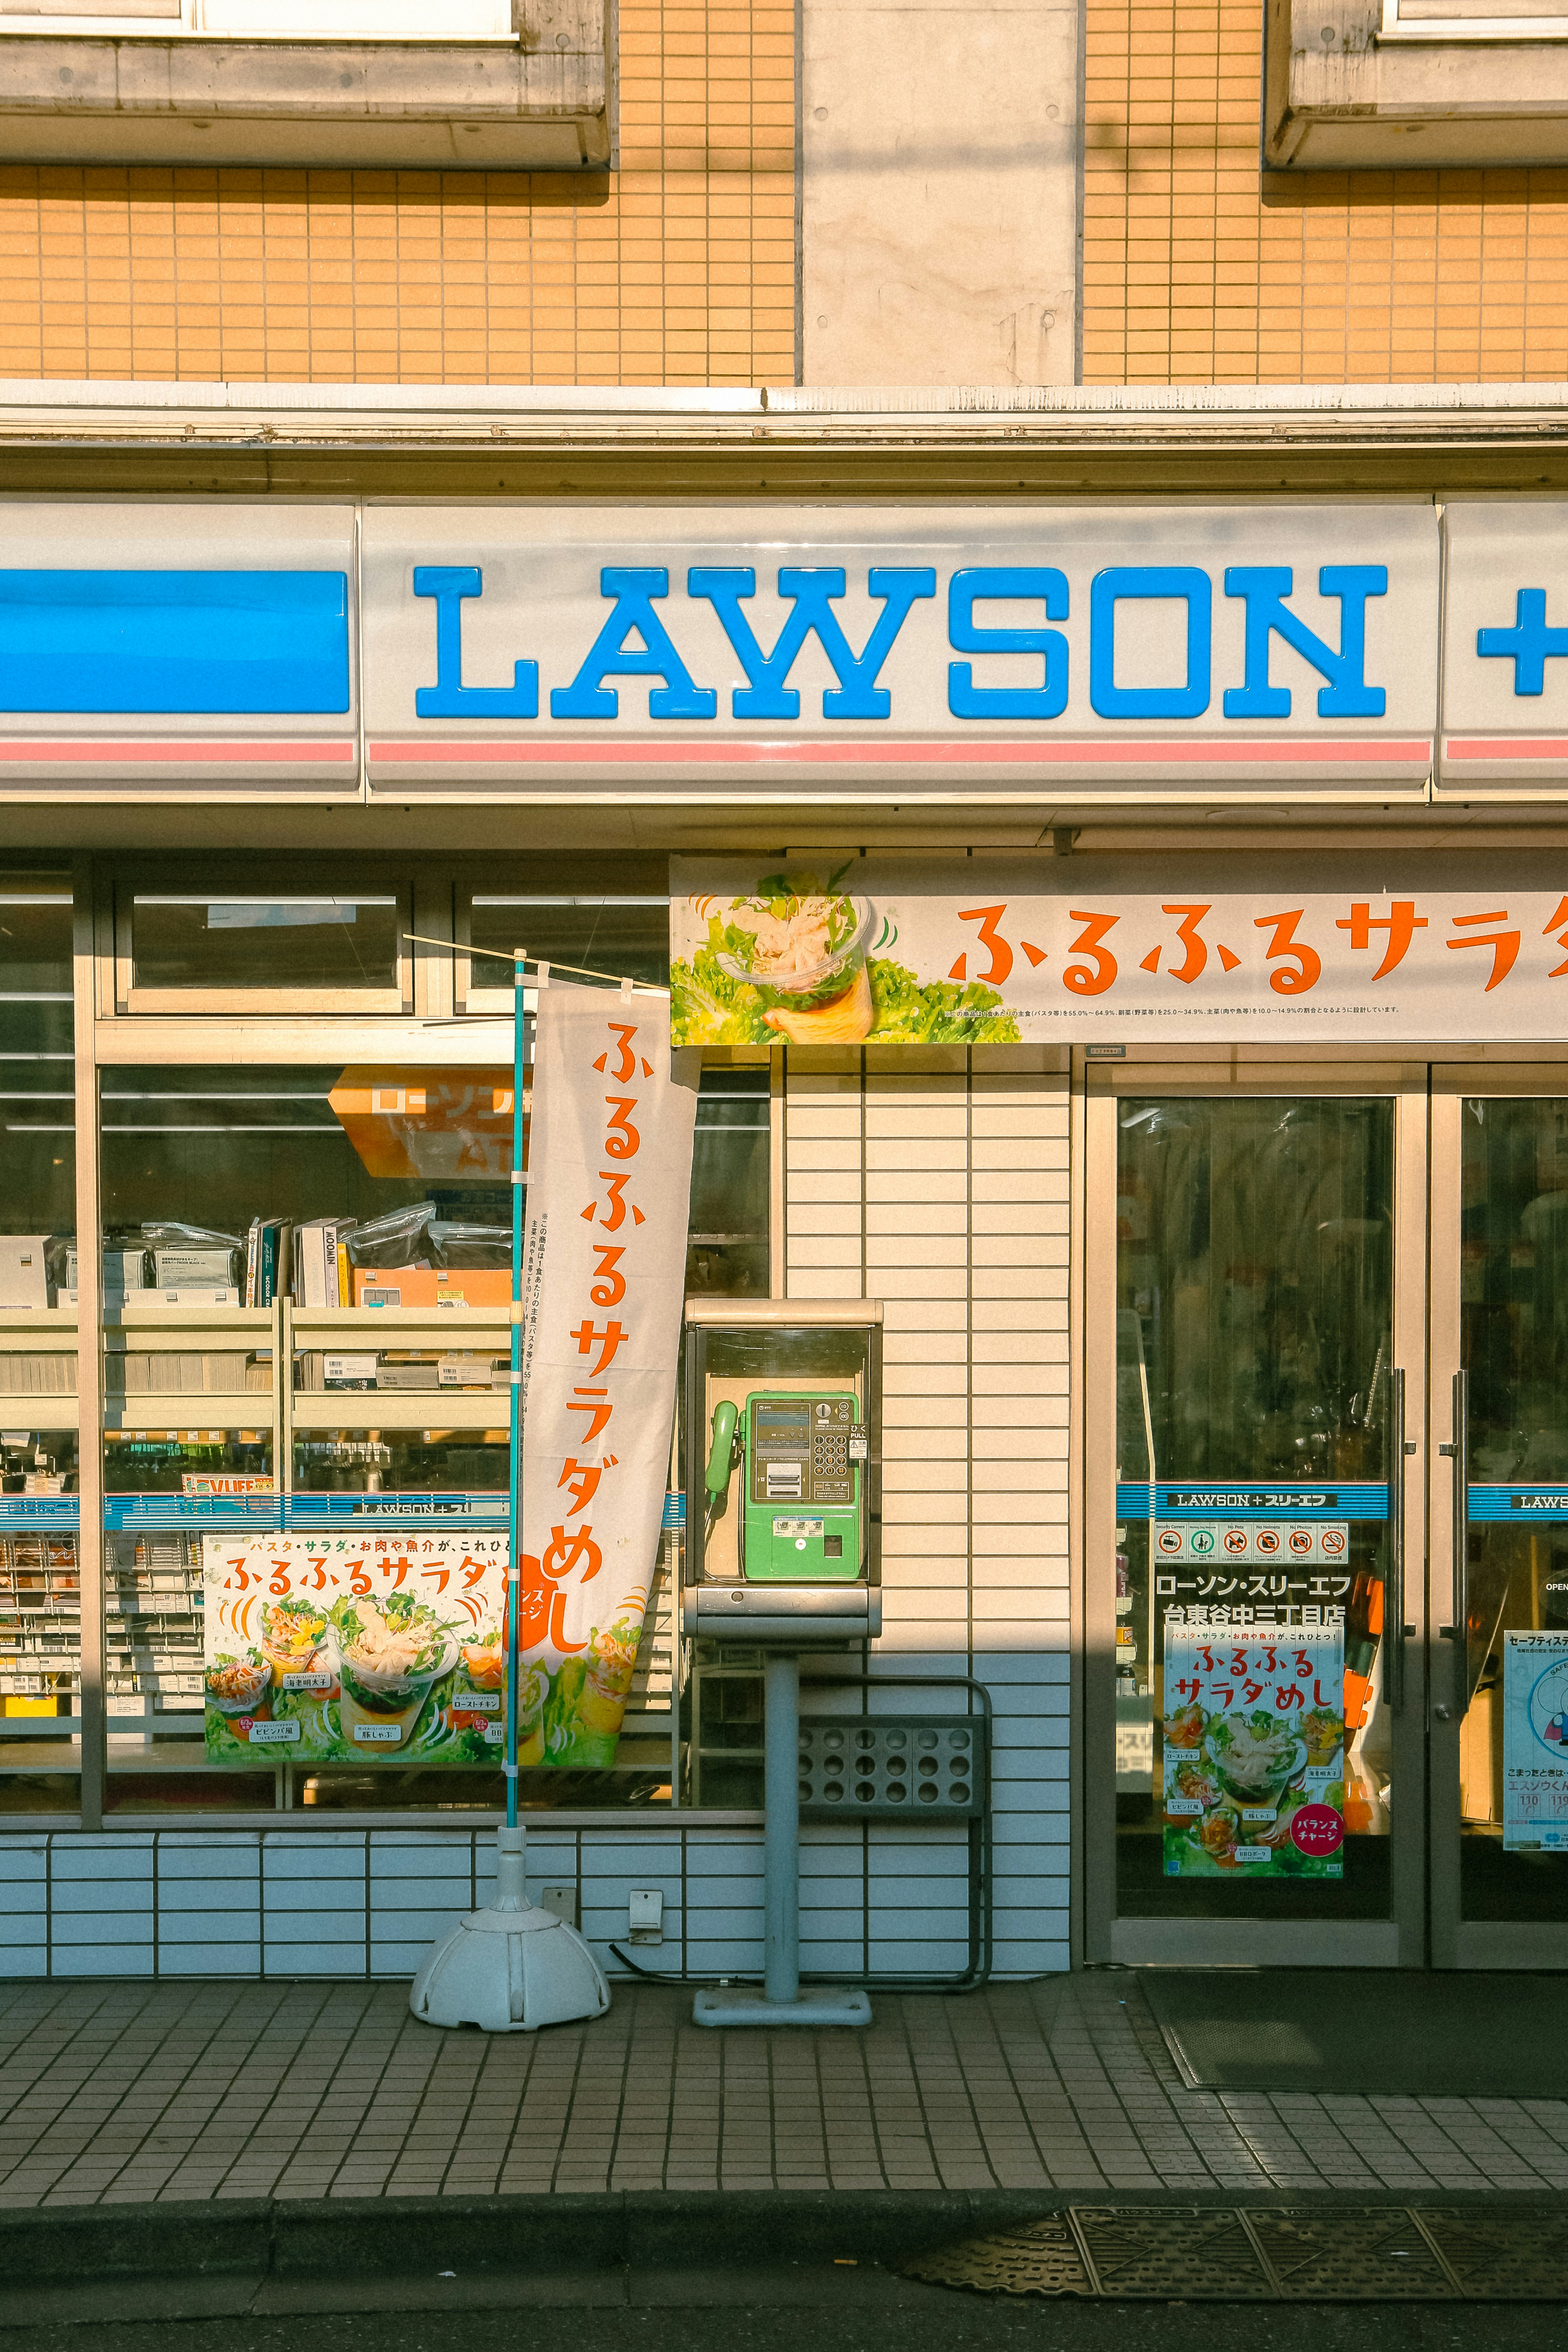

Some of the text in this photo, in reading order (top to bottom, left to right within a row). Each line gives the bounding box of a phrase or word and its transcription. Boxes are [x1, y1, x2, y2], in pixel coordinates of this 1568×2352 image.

[413, 565, 1388, 719] LAWSON
[326, 1231, 335, 1265] MOOMIN
[542, 1022, 655, 1653] ふるふるサラダめし
[1177, 1494, 1249, 1507] LAWSON
[1265, 1494, 1326, 1507] スリーエフ
[223, 1555, 510, 1596] ふるふるサラダ
[1156, 1575, 1351, 1597] ローソン・スリーエフ
[1163, 1604, 1346, 1627] 台東谷中三丁目店
[1192, 1644, 1314, 1678] ふるふる
[286, 1679, 327, 1688] 海老明太子
[1174, 1677, 1333, 1711] サラダめし
[1520, 1795, 1539, 1806] 110
[1297, 1819, 1338, 1829] バランス
[1297, 1831, 1338, 1842] チャージ
